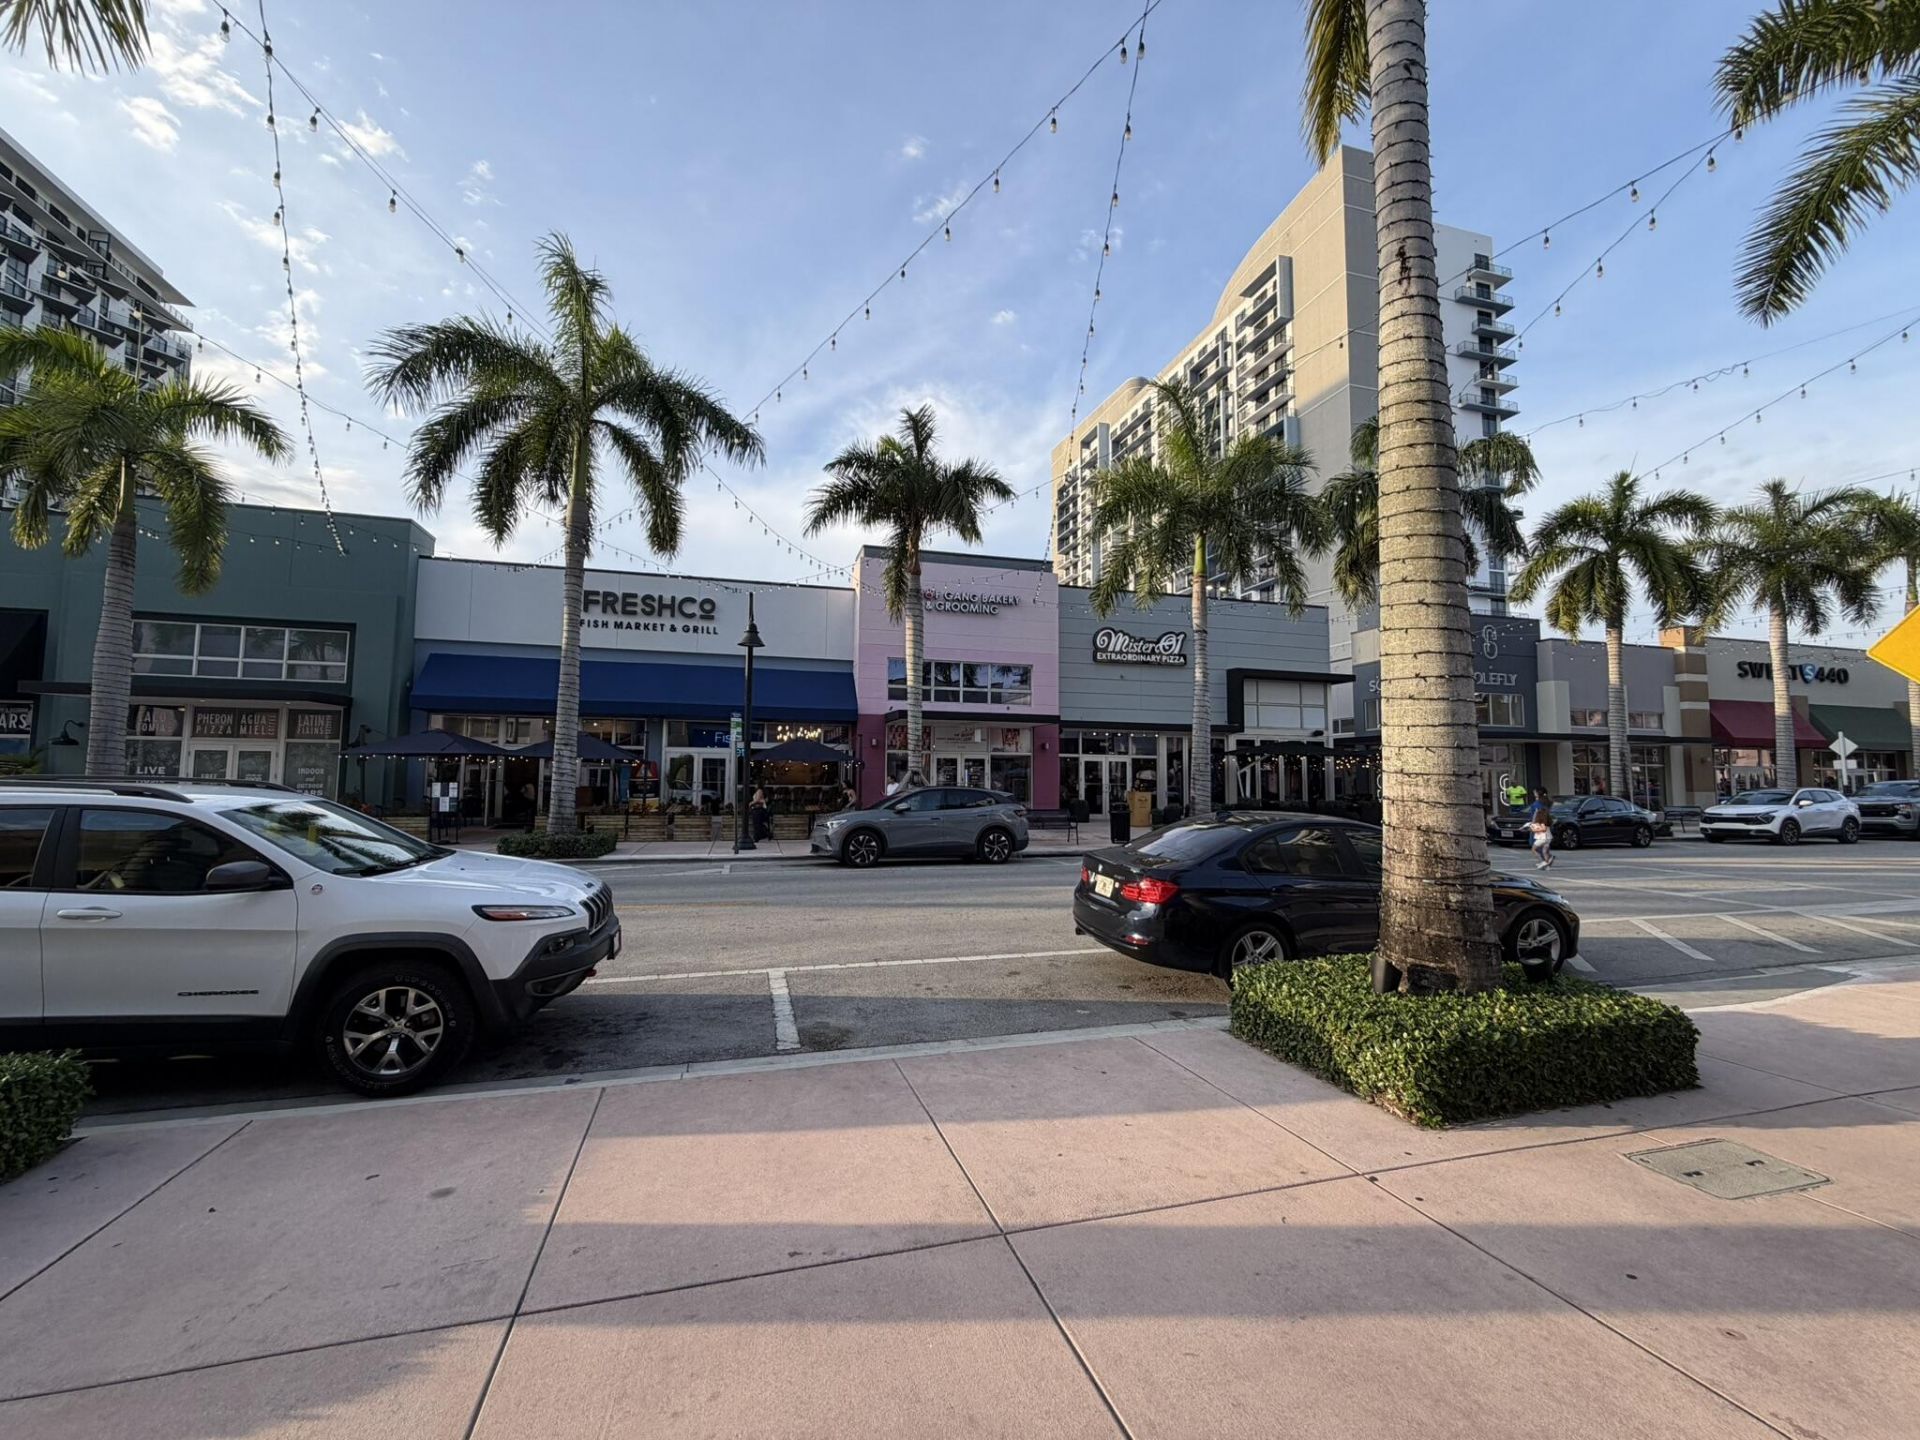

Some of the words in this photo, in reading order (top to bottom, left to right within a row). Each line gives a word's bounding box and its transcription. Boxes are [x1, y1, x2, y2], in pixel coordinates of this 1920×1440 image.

[945, 591, 980, 602] GANG
[982, 594, 1021, 606] BAKERY
[937, 602, 1000, 615] GROOMING
[580, 619, 609, 629] FISH
[614, 621, 666, 632] MARKET
[670, 624, 678, 633] &
[682, 625, 720, 635] GRILL
[1096, 629, 1157, 653] Mister
[1097, 652, 1161, 663] EXTRAORDINARY
[1163, 655, 1185, 664] PIZZA
[194, 724, 233, 736] PIZZA
[136, 766, 167, 775] LIVE
